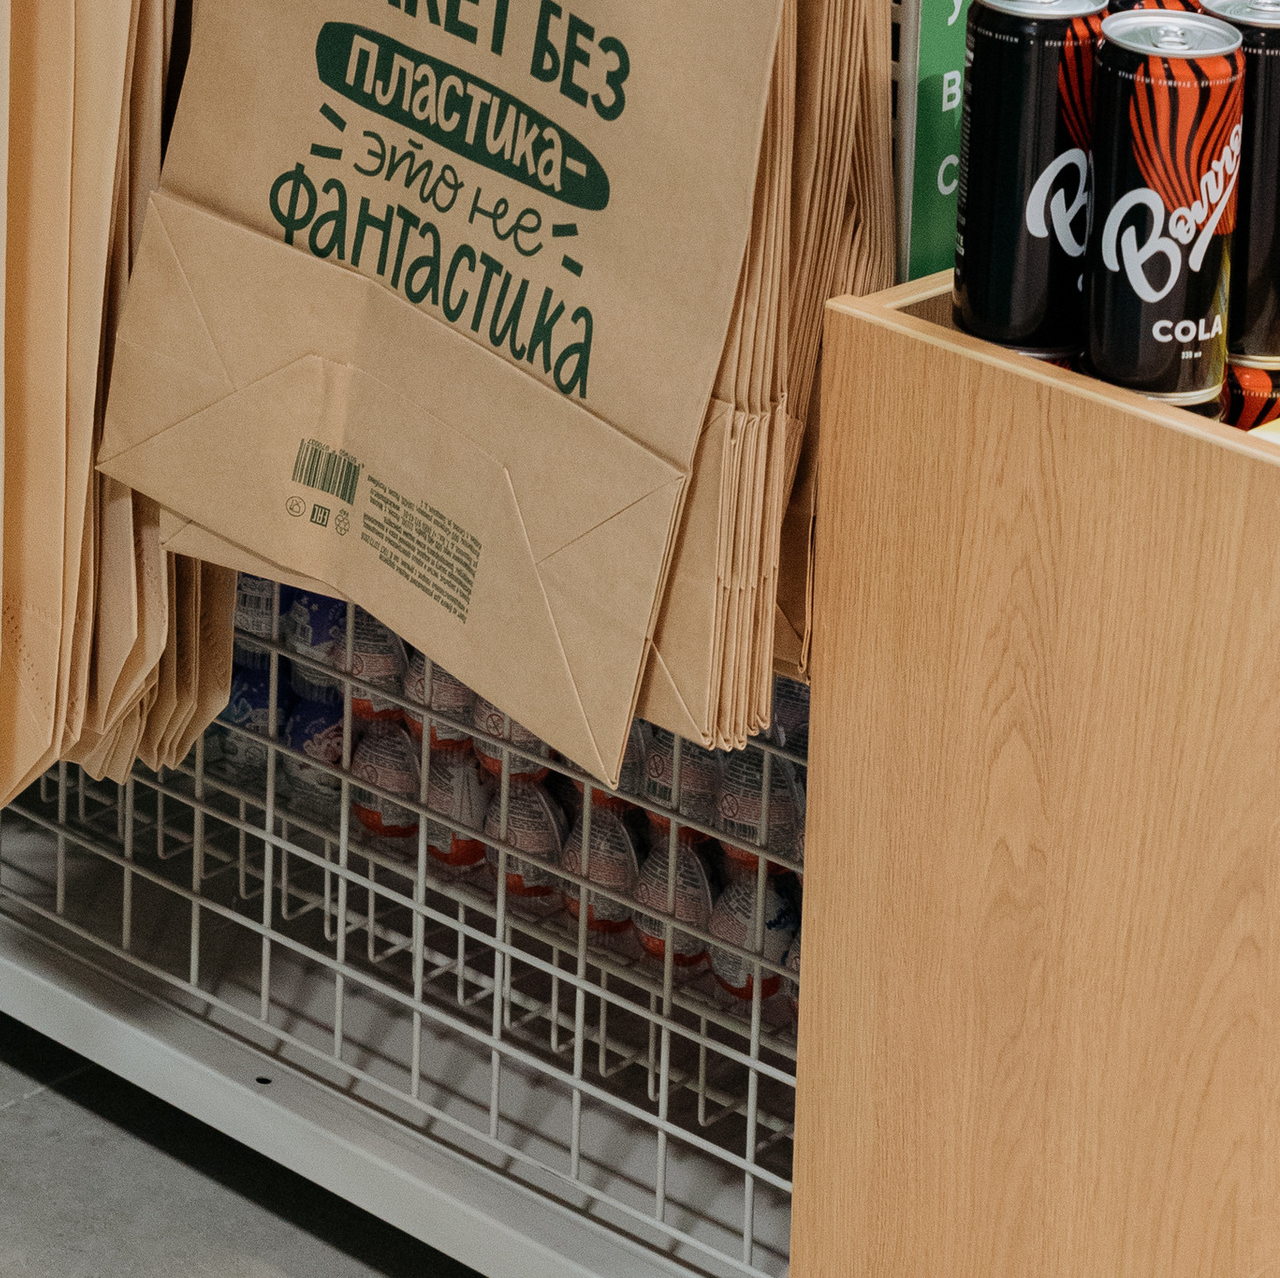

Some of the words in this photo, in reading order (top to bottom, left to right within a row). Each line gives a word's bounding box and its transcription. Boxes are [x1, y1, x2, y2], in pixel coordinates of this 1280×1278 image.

[353, 130, 465, 214] это
[469, 186, 544, 257] не
[1151, 314, 1223, 343] COLA
